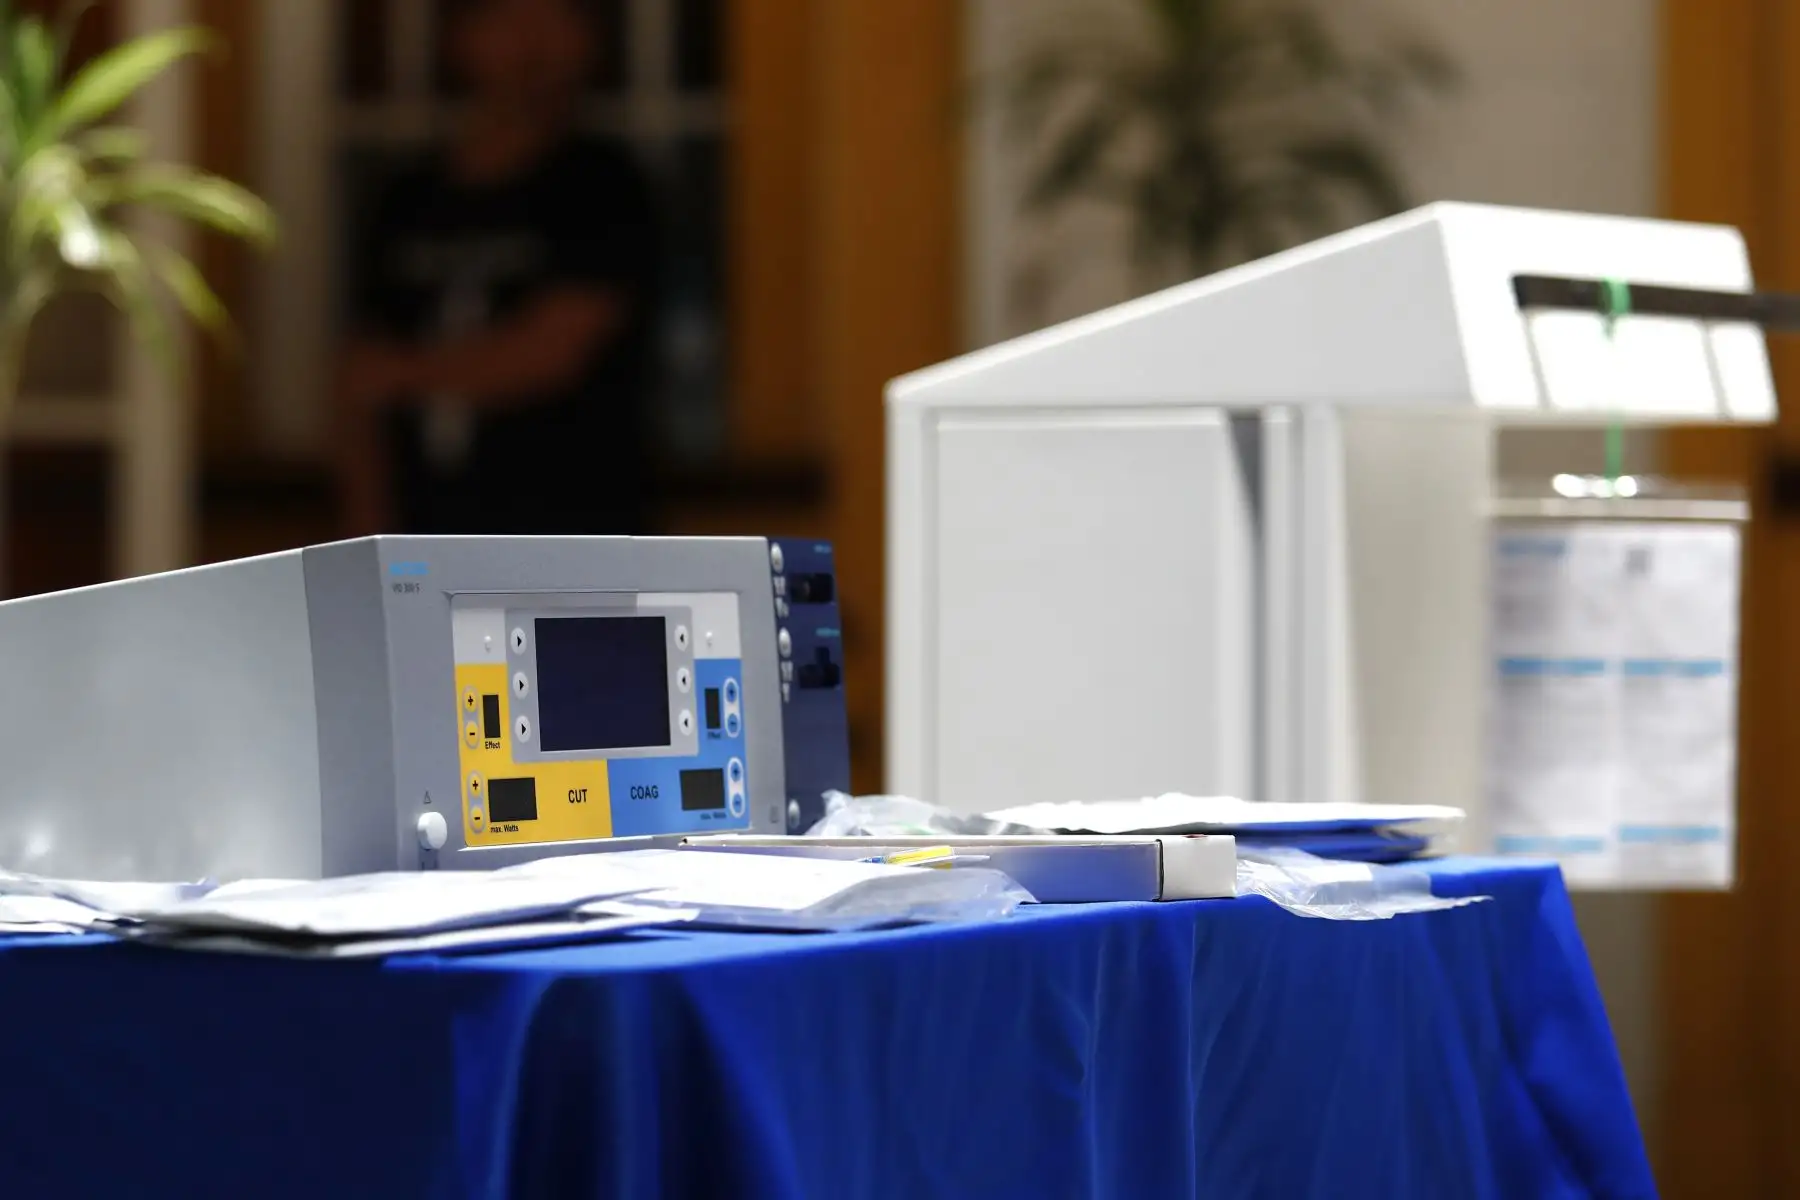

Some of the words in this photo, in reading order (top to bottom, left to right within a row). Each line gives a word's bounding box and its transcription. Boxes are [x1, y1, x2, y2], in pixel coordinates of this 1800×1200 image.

[485, 741, 501, 749] Effect
[568, 789, 588, 803] CUT
[630, 785, 659, 800] COAG
[503, 824, 519, 832] Watts
